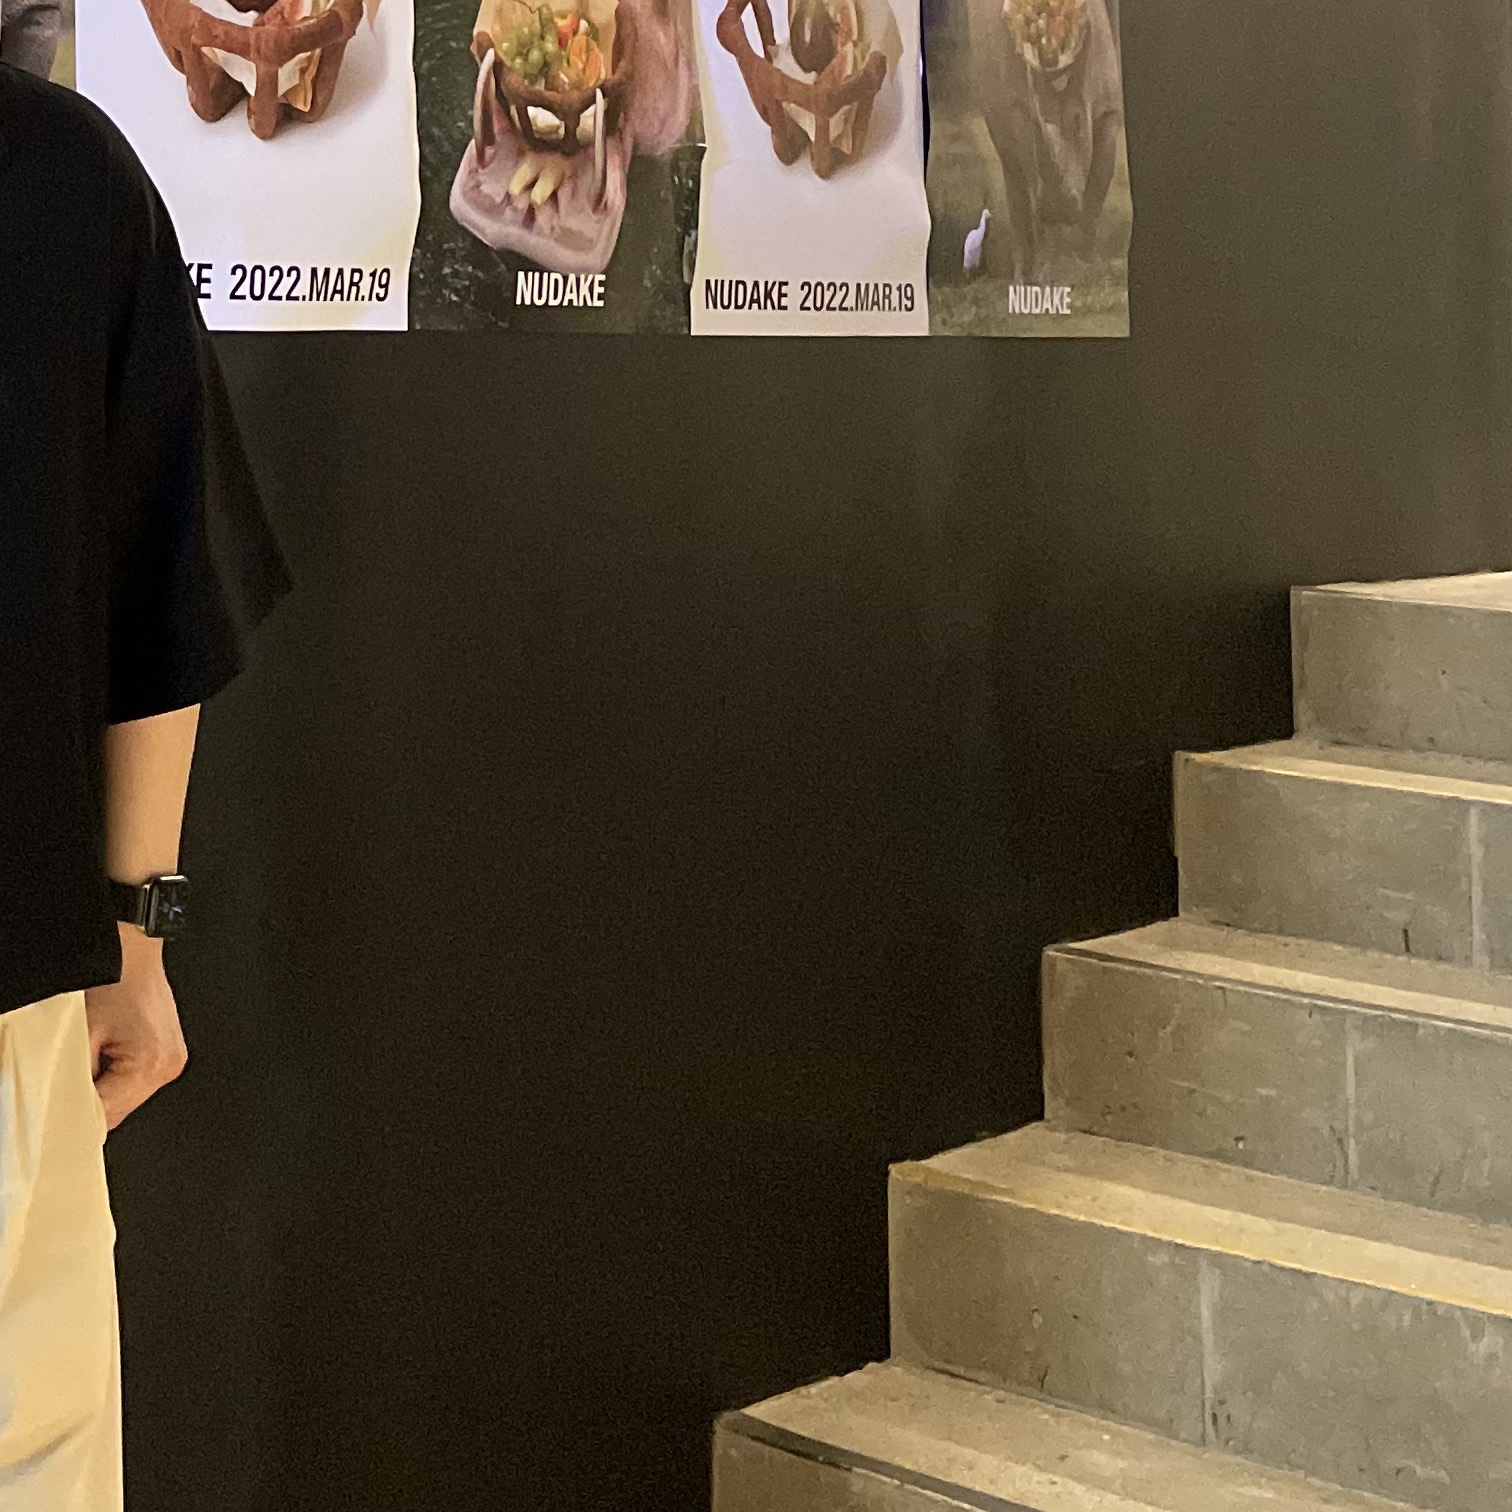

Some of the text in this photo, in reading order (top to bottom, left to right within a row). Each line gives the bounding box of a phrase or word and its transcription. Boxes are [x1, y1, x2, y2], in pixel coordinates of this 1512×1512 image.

[228, 263, 391, 302] 2022.MAR.19
[515, 271, 606, 307] NUDAKE
[704, 278, 915, 313] NUDAKE 2022.MAR.19
[1008, 285, 1071, 315] NUDAKE
